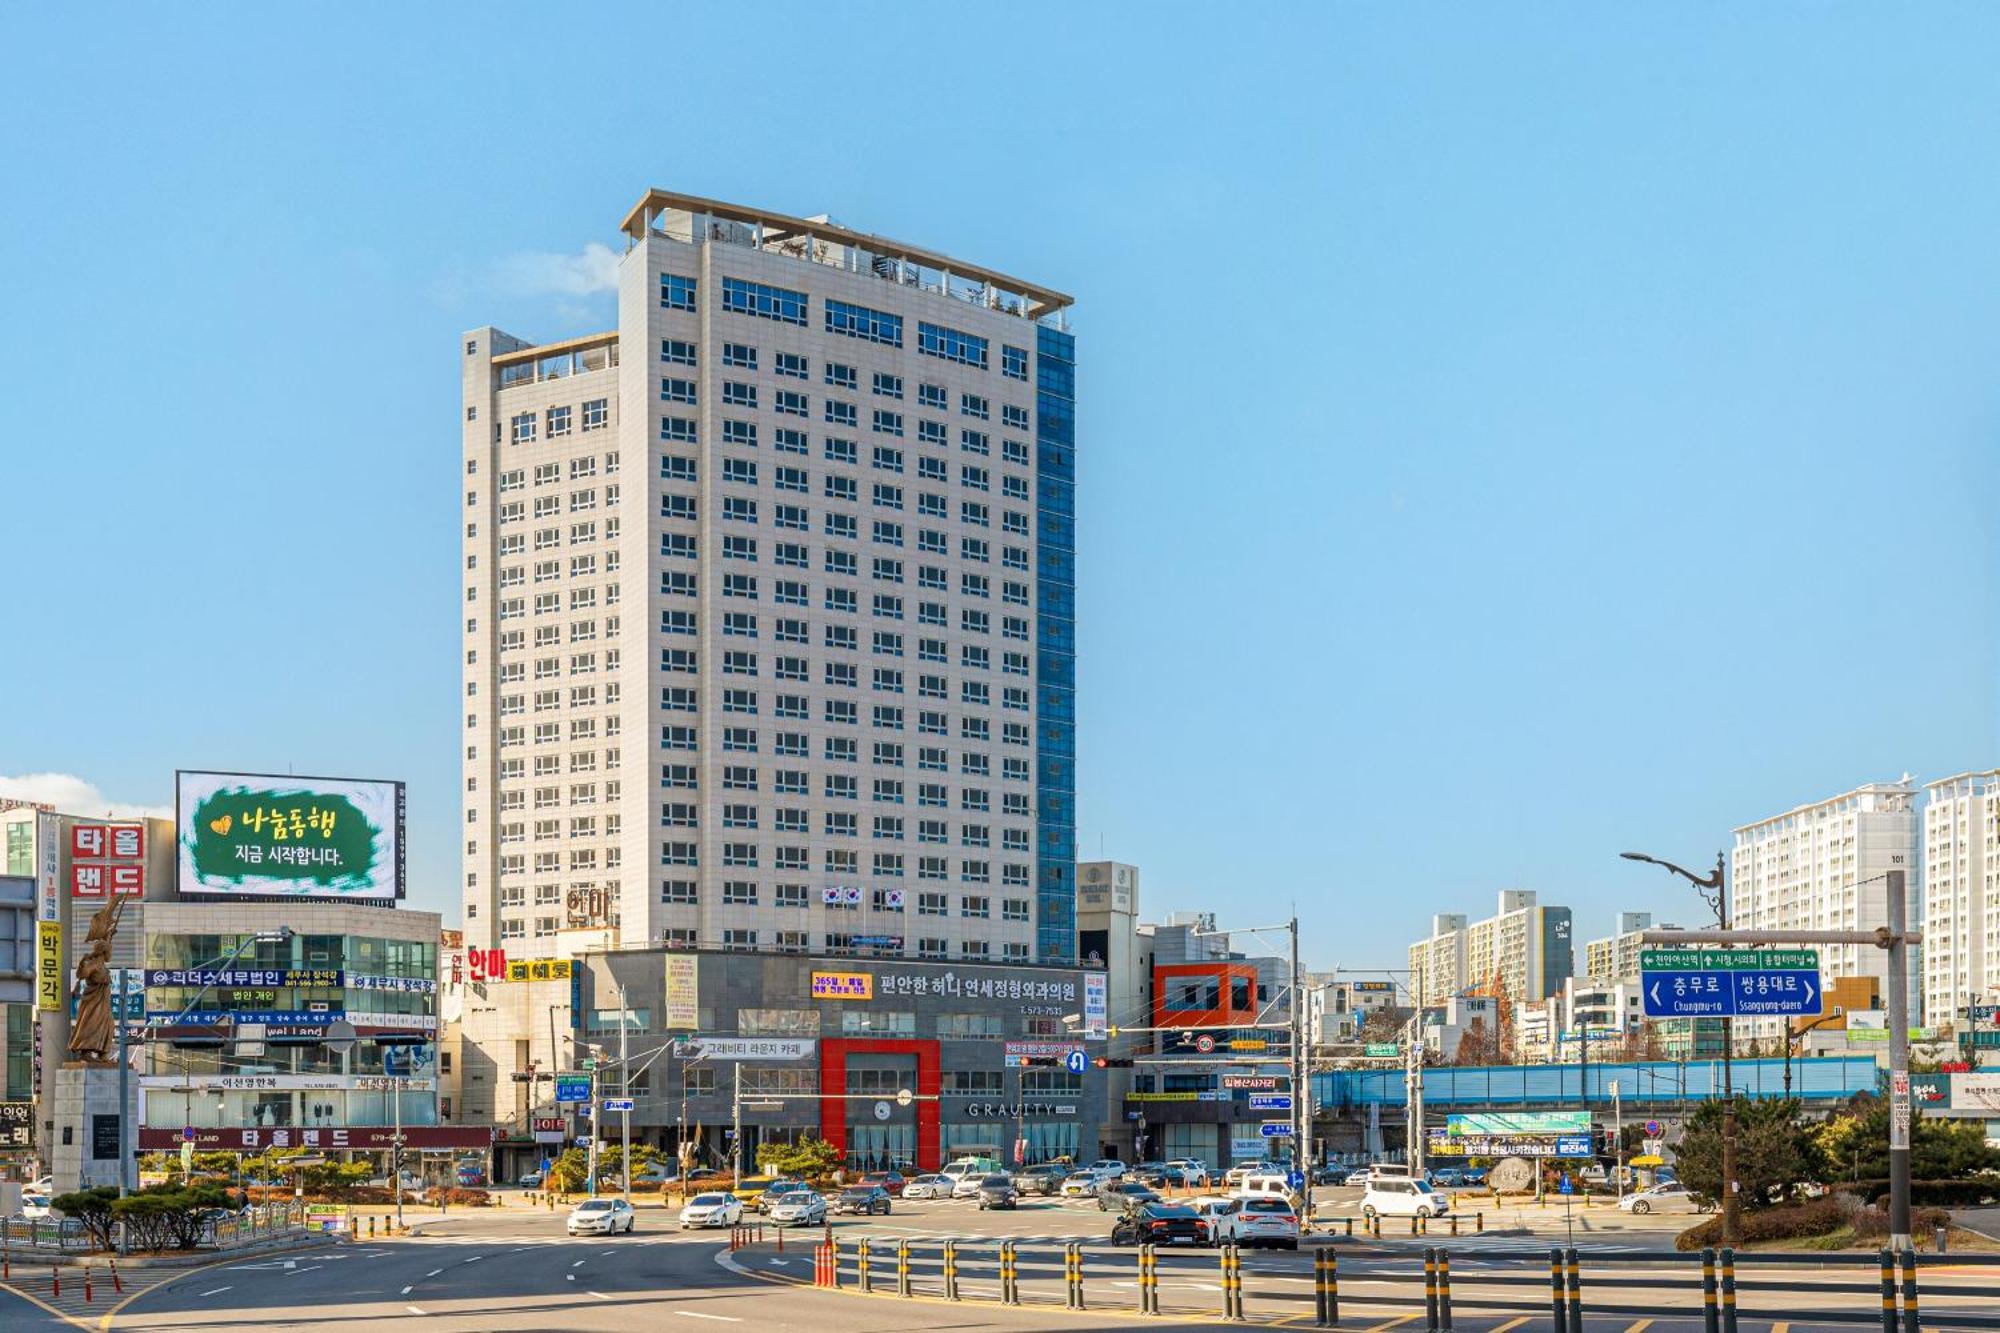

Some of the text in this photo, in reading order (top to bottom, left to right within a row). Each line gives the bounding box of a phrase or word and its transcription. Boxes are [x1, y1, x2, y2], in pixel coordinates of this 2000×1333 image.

[242, 806, 336, 840] 나눔동행
[77, 829, 138, 855] 타올
[235, 845, 344, 866] 지금 시작합니다.
[1891, 855, 1904, 864] 101
[77, 868, 138, 894] 랜드
[42, 935, 59, 1001] 박문각
[468, 949, 506, 981] 안마
[1656, 955, 1698, 966] 천안아산역
[1764, 956, 1805, 966] 종합터미널
[172, 970, 279, 986] 리더스세무법인
[369, 977, 398, 989] 세무사
[1674, 977, 1720, 997] 충무로
[1740, 976, 1798, 995] 쌍용대로
[881, 975, 928, 996] 편안한
[965, 978, 1075, 1001] 연세정형외과의원
[1674, 1002, 1722, 1014] Chungmu-ro
[1739, 1001, 1802, 1014] Ssangyong-daero
[708, 1043, 800, 1056] 그래비티 라운지 카페
[1224, 1078, 1276, 1088] 일봉산사거리
[242, 1129, 349, 1147] 타올랜드
